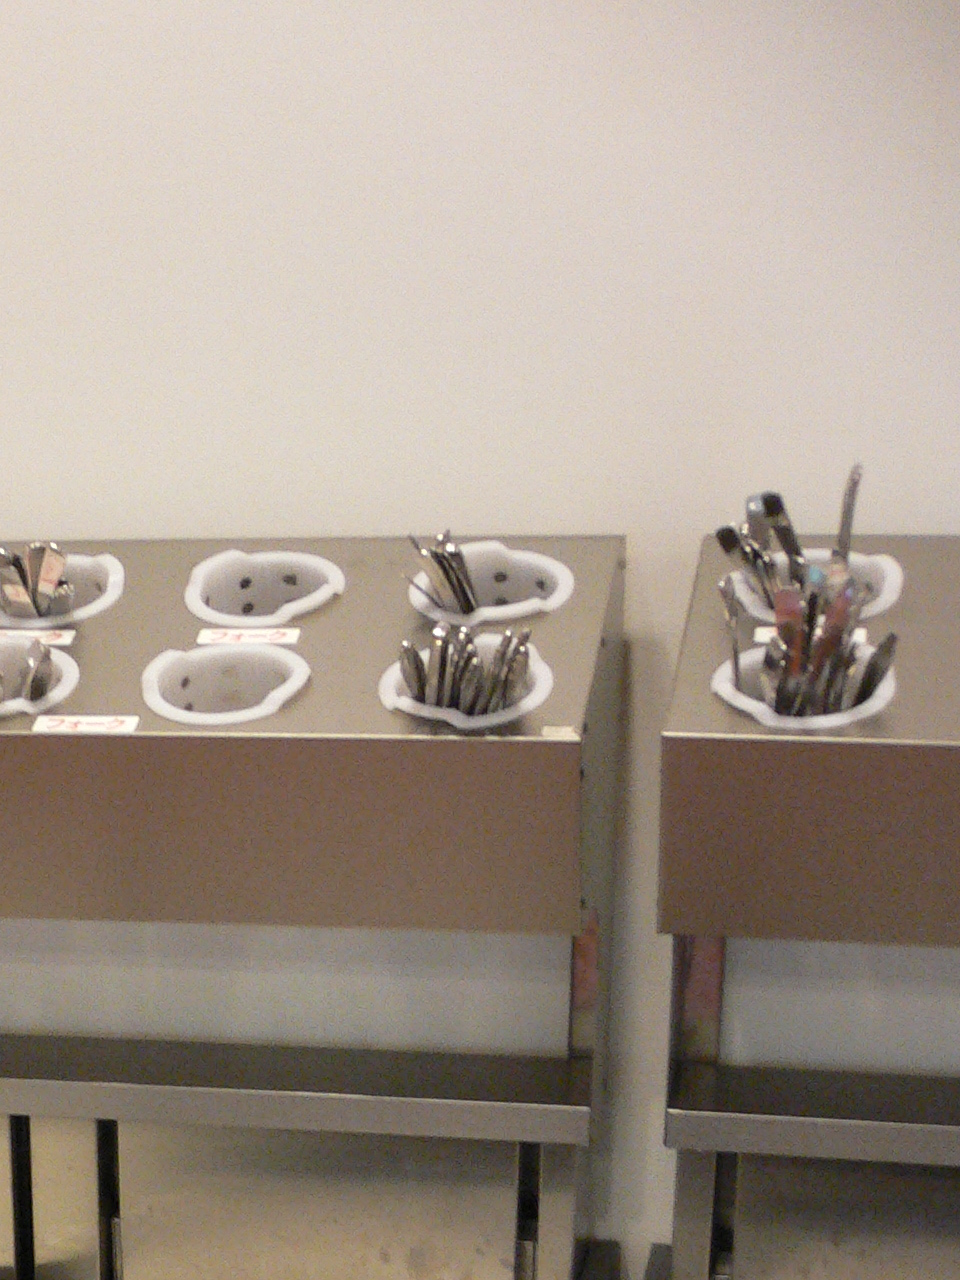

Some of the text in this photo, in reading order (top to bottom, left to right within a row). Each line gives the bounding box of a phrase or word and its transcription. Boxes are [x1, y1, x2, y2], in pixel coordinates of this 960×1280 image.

[210, 629, 288, 643] フォーク
[46, 717, 126, 731] フォーク
